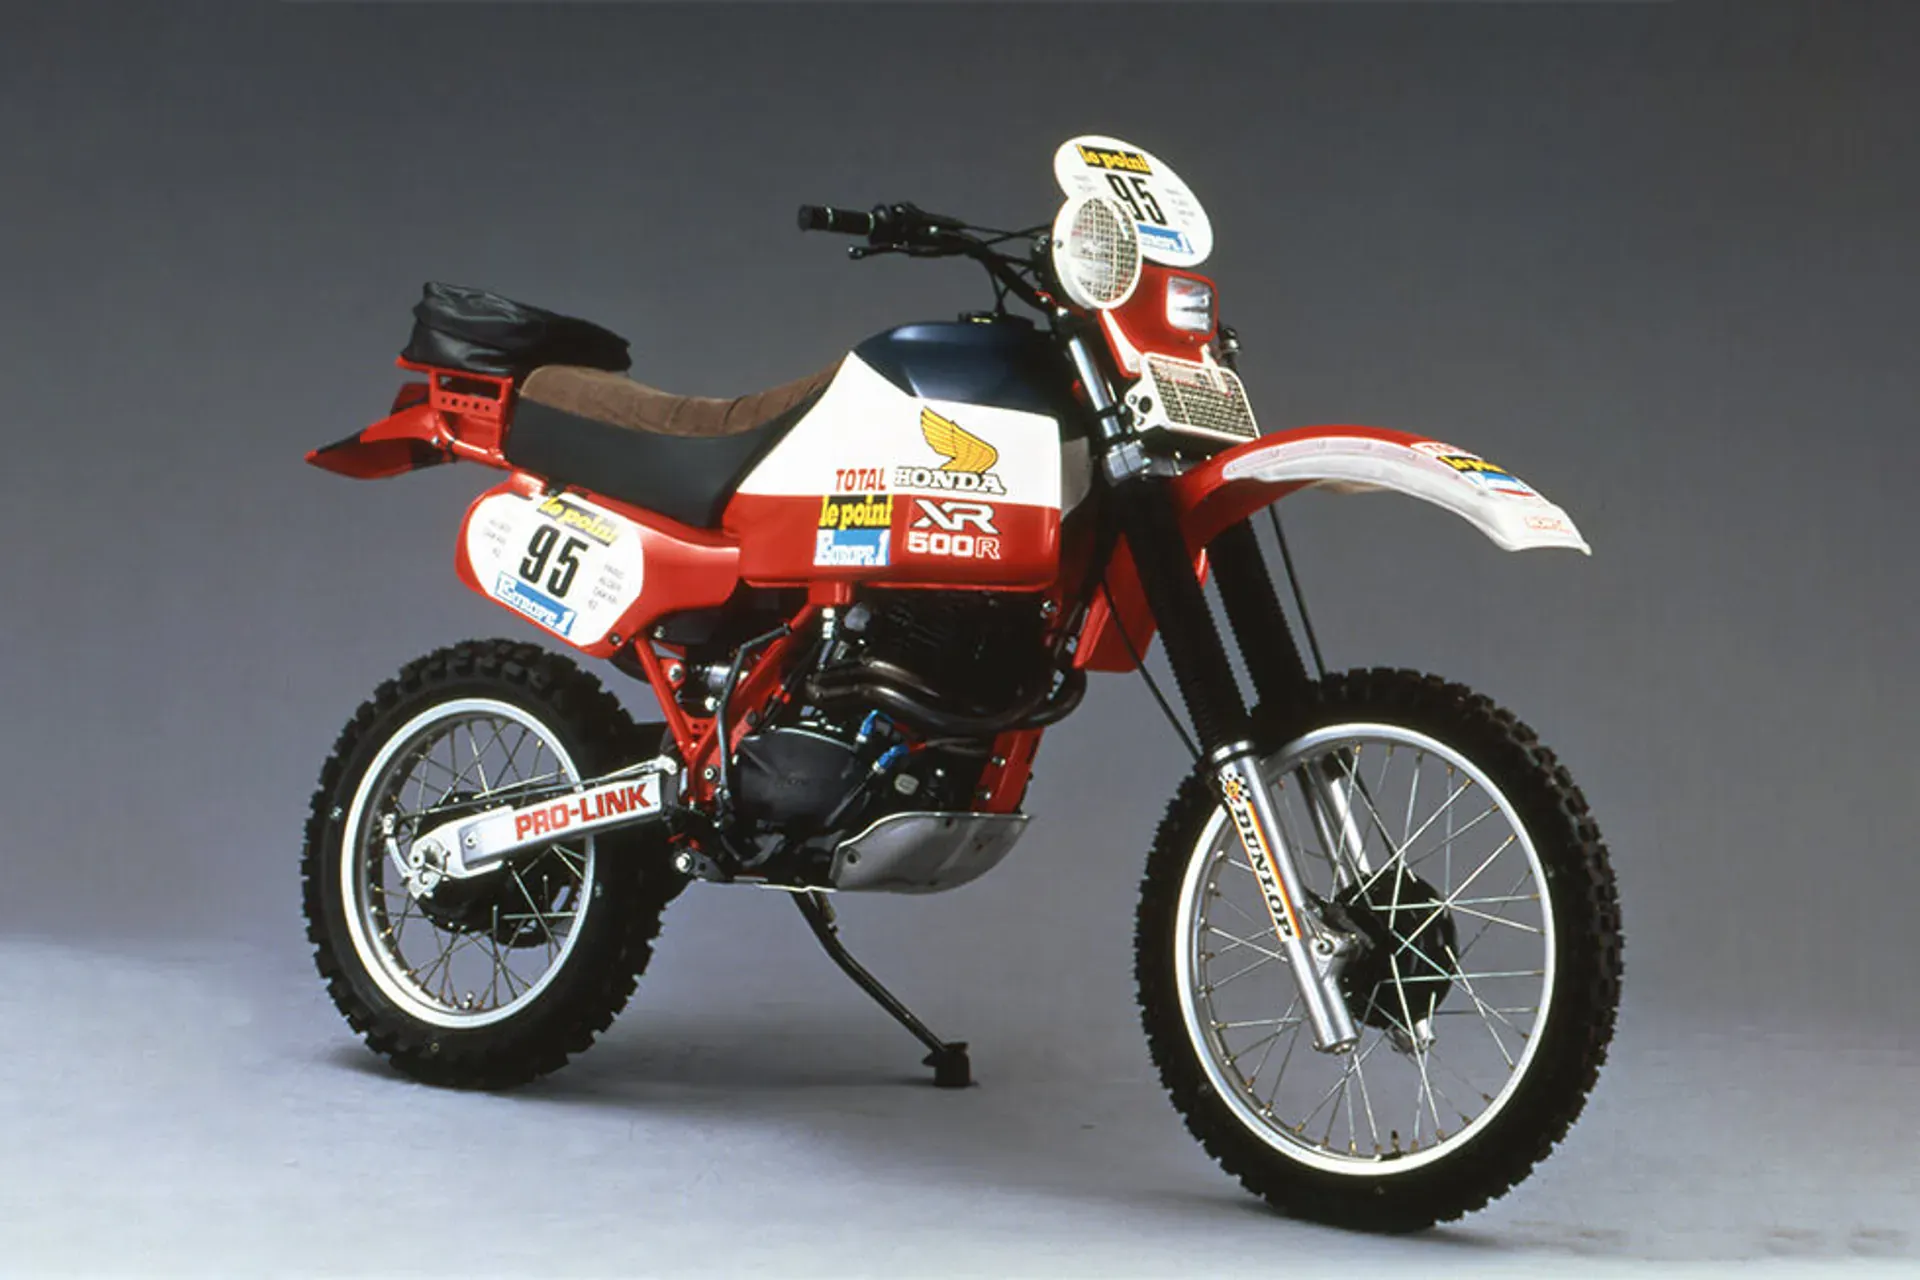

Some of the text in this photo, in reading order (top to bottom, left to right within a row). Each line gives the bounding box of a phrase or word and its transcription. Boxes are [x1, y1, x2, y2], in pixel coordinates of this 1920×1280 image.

[1105, 173, 1168, 225] 95
[836, 468, 887, 492] TOTAL
[893, 466, 1007, 496] HONDA
[538, 496, 621, 546] le point
[819, 494, 894, 531] le point
[912, 499, 1002, 534] XR
[519, 523, 590, 599] 95
[875, 529, 889, 566] 1
[907, 531, 1002, 560] 500R
[558, 610, 574, 636] 1
[514, 783, 652, 841] PRO-LINK
[1235, 808, 1293, 937] DUNLOP
